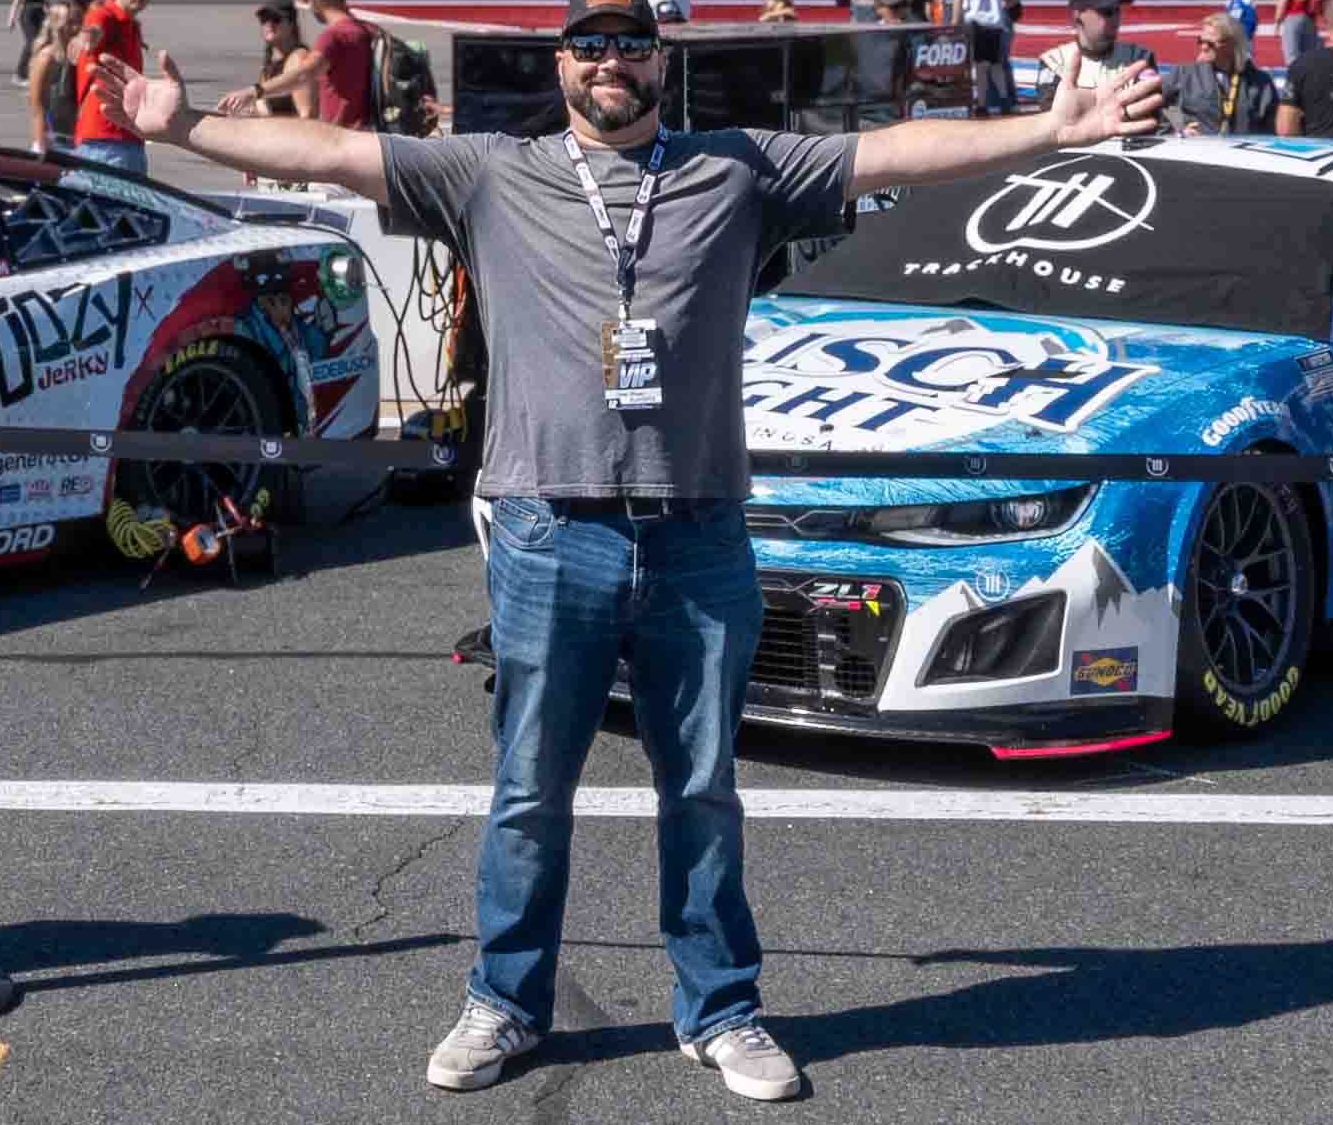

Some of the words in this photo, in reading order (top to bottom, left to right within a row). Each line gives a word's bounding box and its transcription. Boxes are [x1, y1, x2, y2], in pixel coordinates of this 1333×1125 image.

[916, 42, 967, 67] FORD
[902, 251, 1126, 294] TRACKHOUSE
[619, 362, 657, 389] VIP
